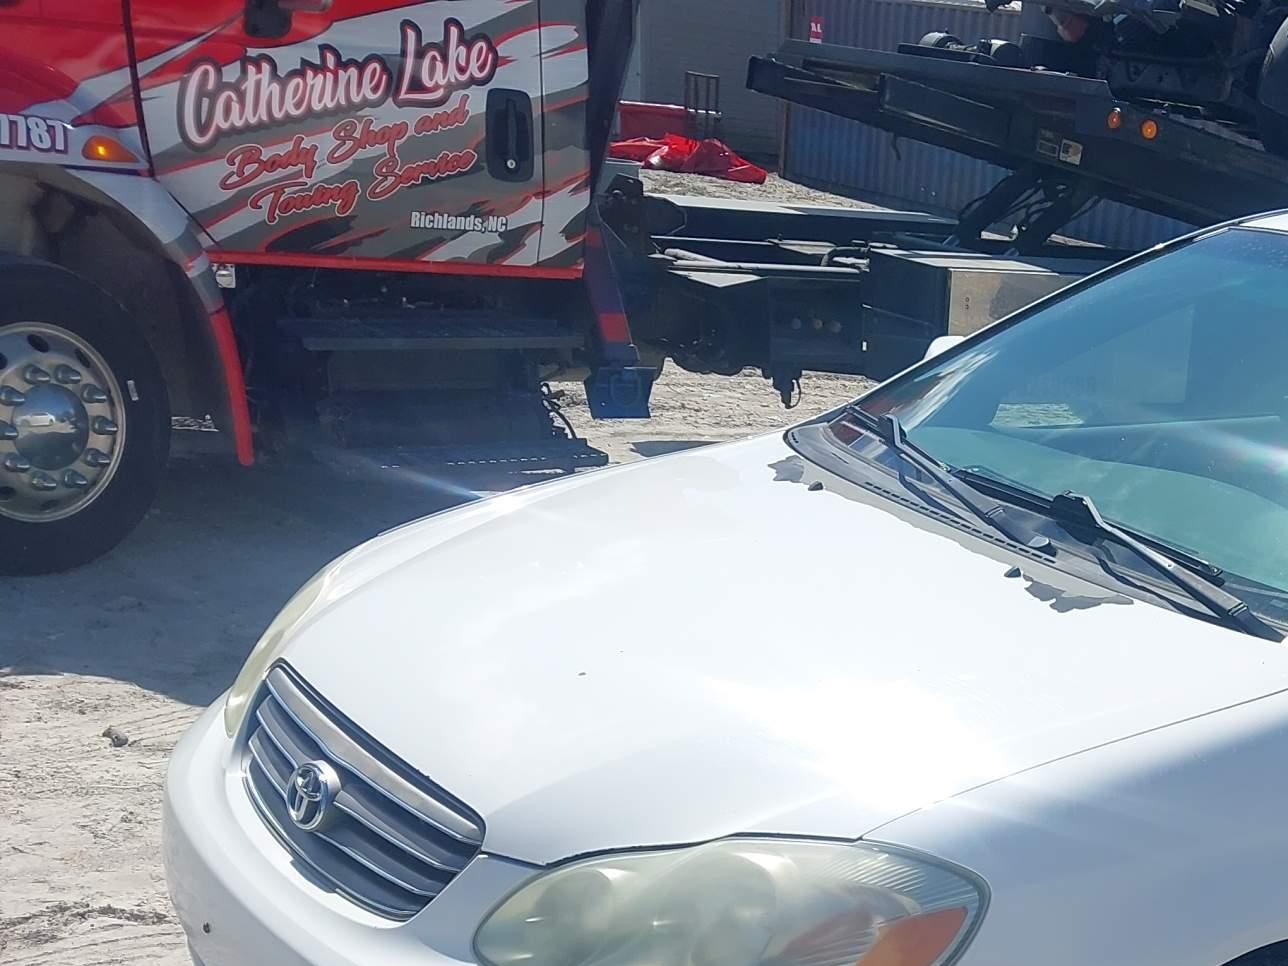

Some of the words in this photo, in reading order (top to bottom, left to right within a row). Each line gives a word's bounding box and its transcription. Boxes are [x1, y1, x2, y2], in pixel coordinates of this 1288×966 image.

[181, 48, 391, 147] Catherine
[396, 22, 495, 101] Lake
[219, 134, 318, 191] Body
[326, 118, 408, 164] Shop
[414, 94, 470, 136] and
[249, 181, 360, 224] Towing
[367, 150, 477, 200] Service
[410, 211, 485, 232] Richlands,
[487, 215, 507, 232] NC
